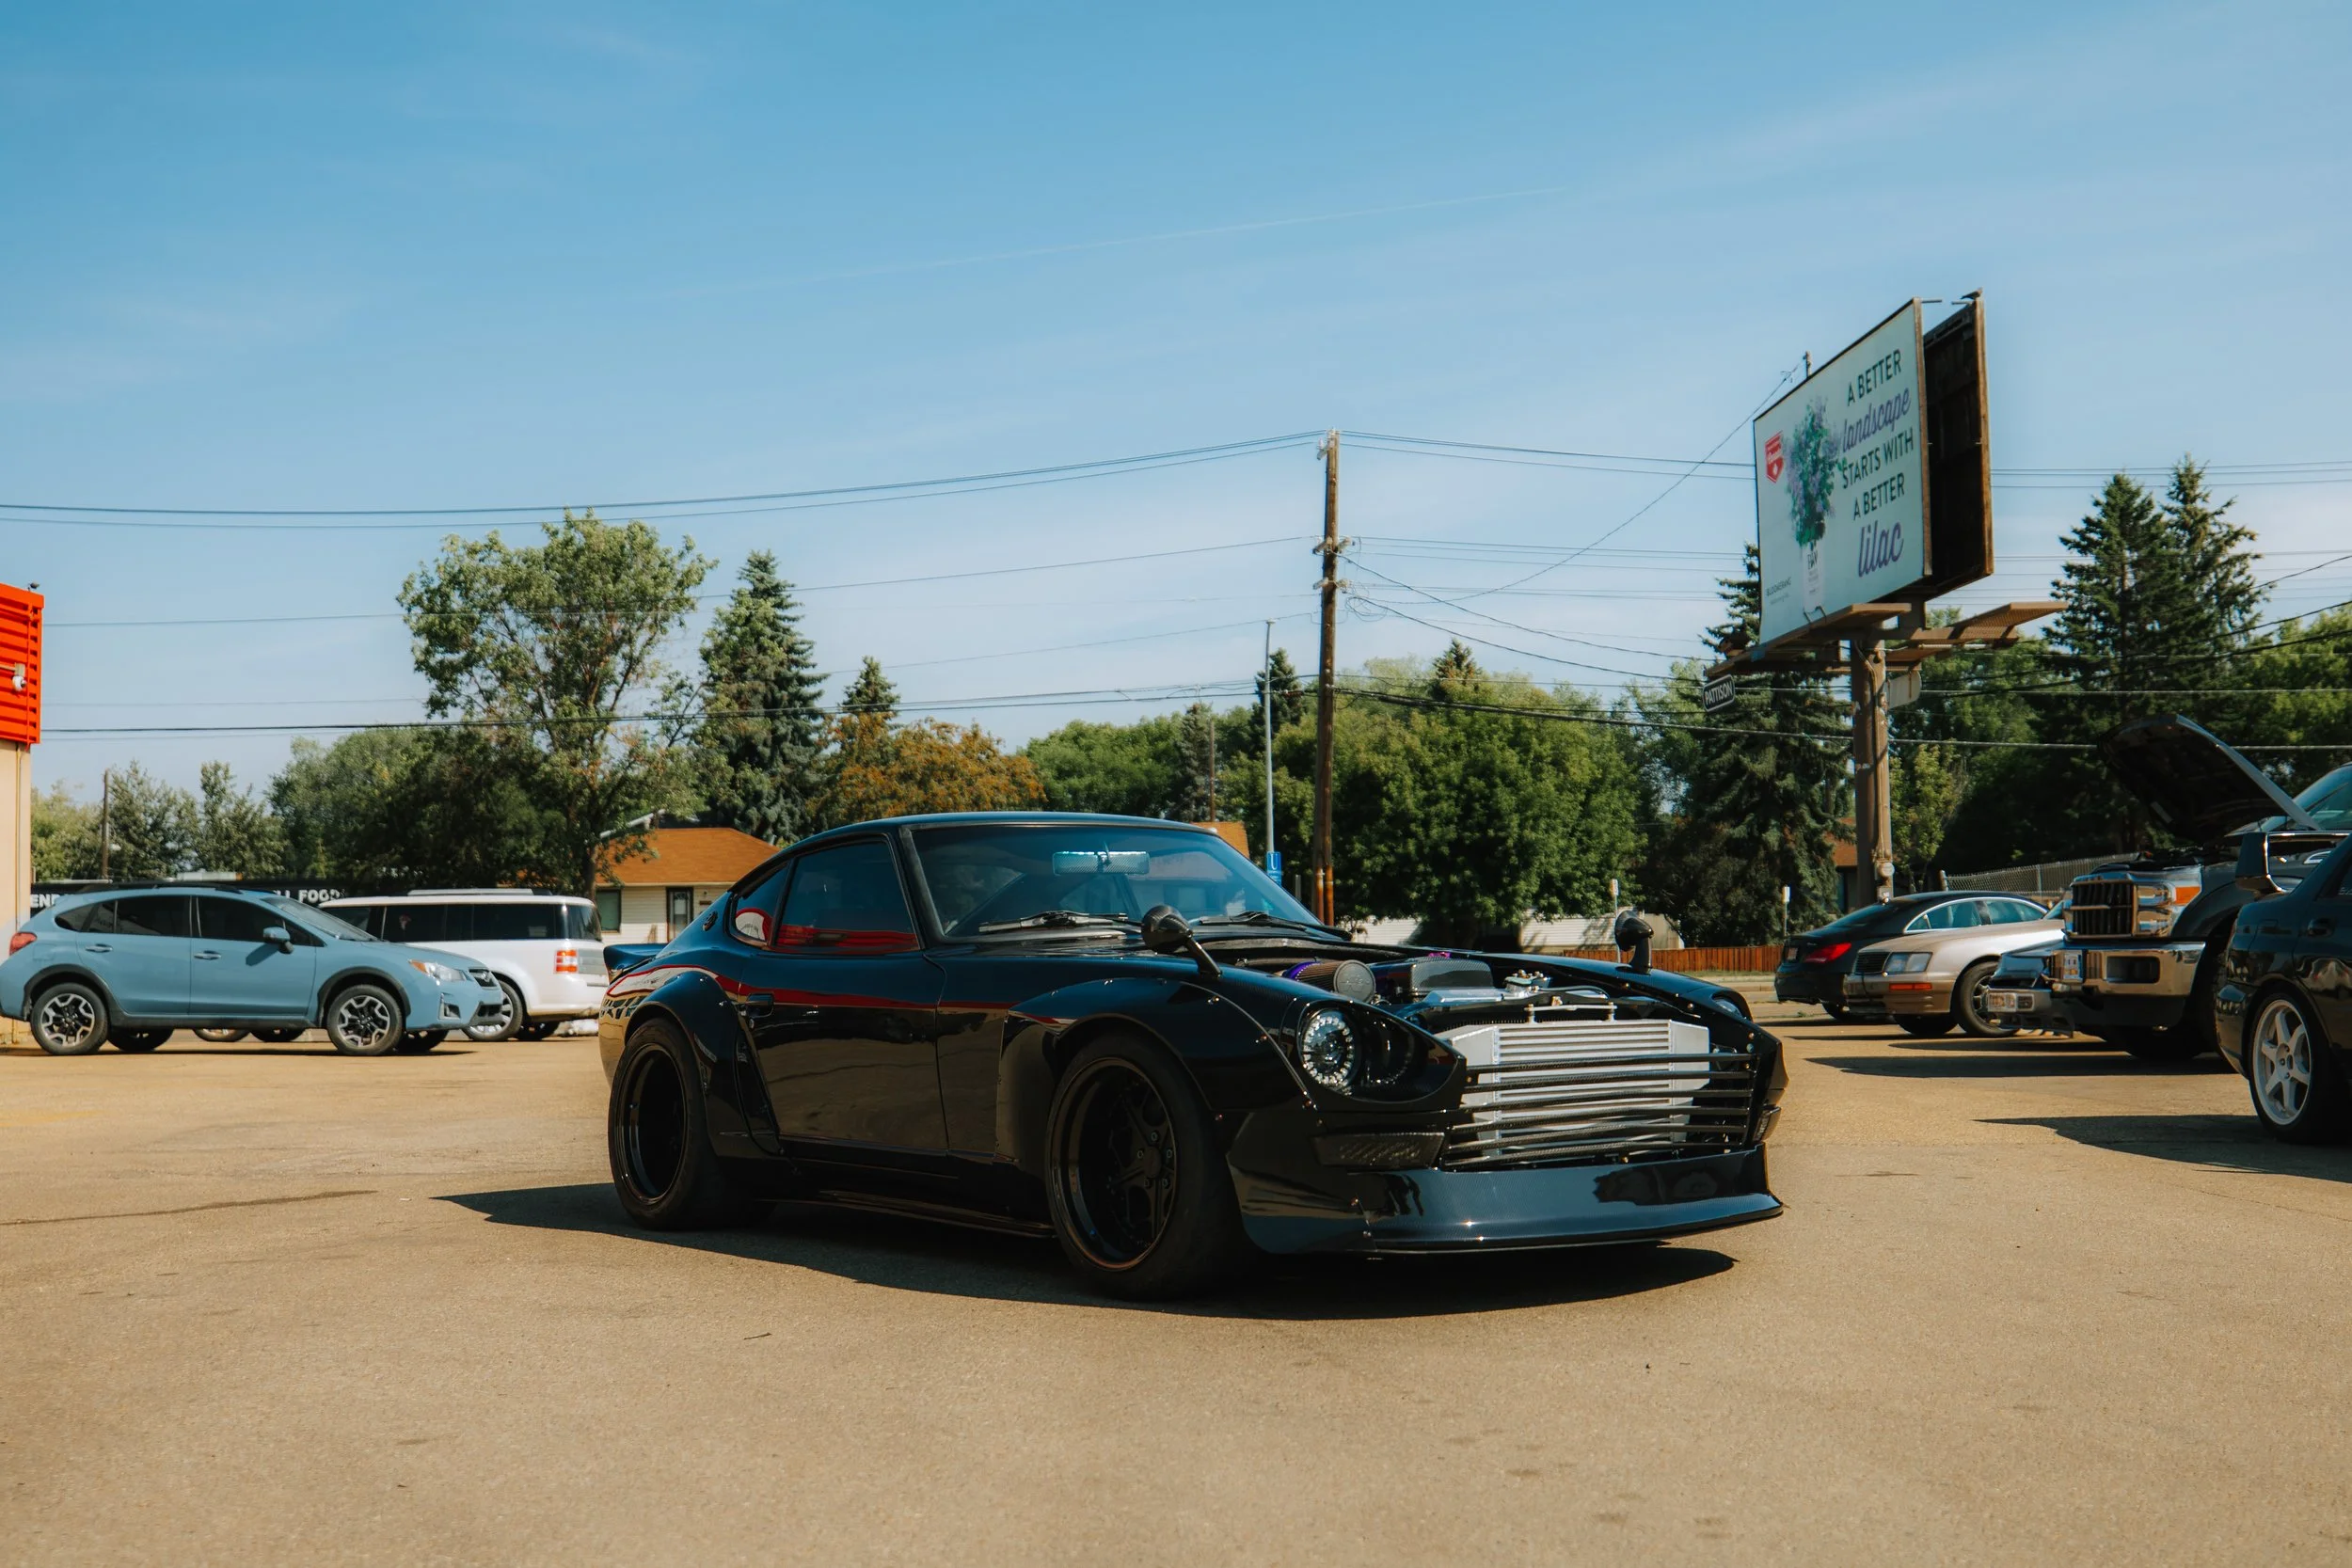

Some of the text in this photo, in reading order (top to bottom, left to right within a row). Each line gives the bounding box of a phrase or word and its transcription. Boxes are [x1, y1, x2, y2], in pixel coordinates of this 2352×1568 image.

[1847, 349, 1901, 406] A BETTER
[1842, 387, 1911, 452] landscape
[1842, 426, 1914, 489] STARTS WITH
[1853, 472, 1905, 521] A BETTER
[1858, 519, 1904, 578] lilac
[1704, 680, 1733, 705] PATTISON
[1270, 853, 1278, 870] U
